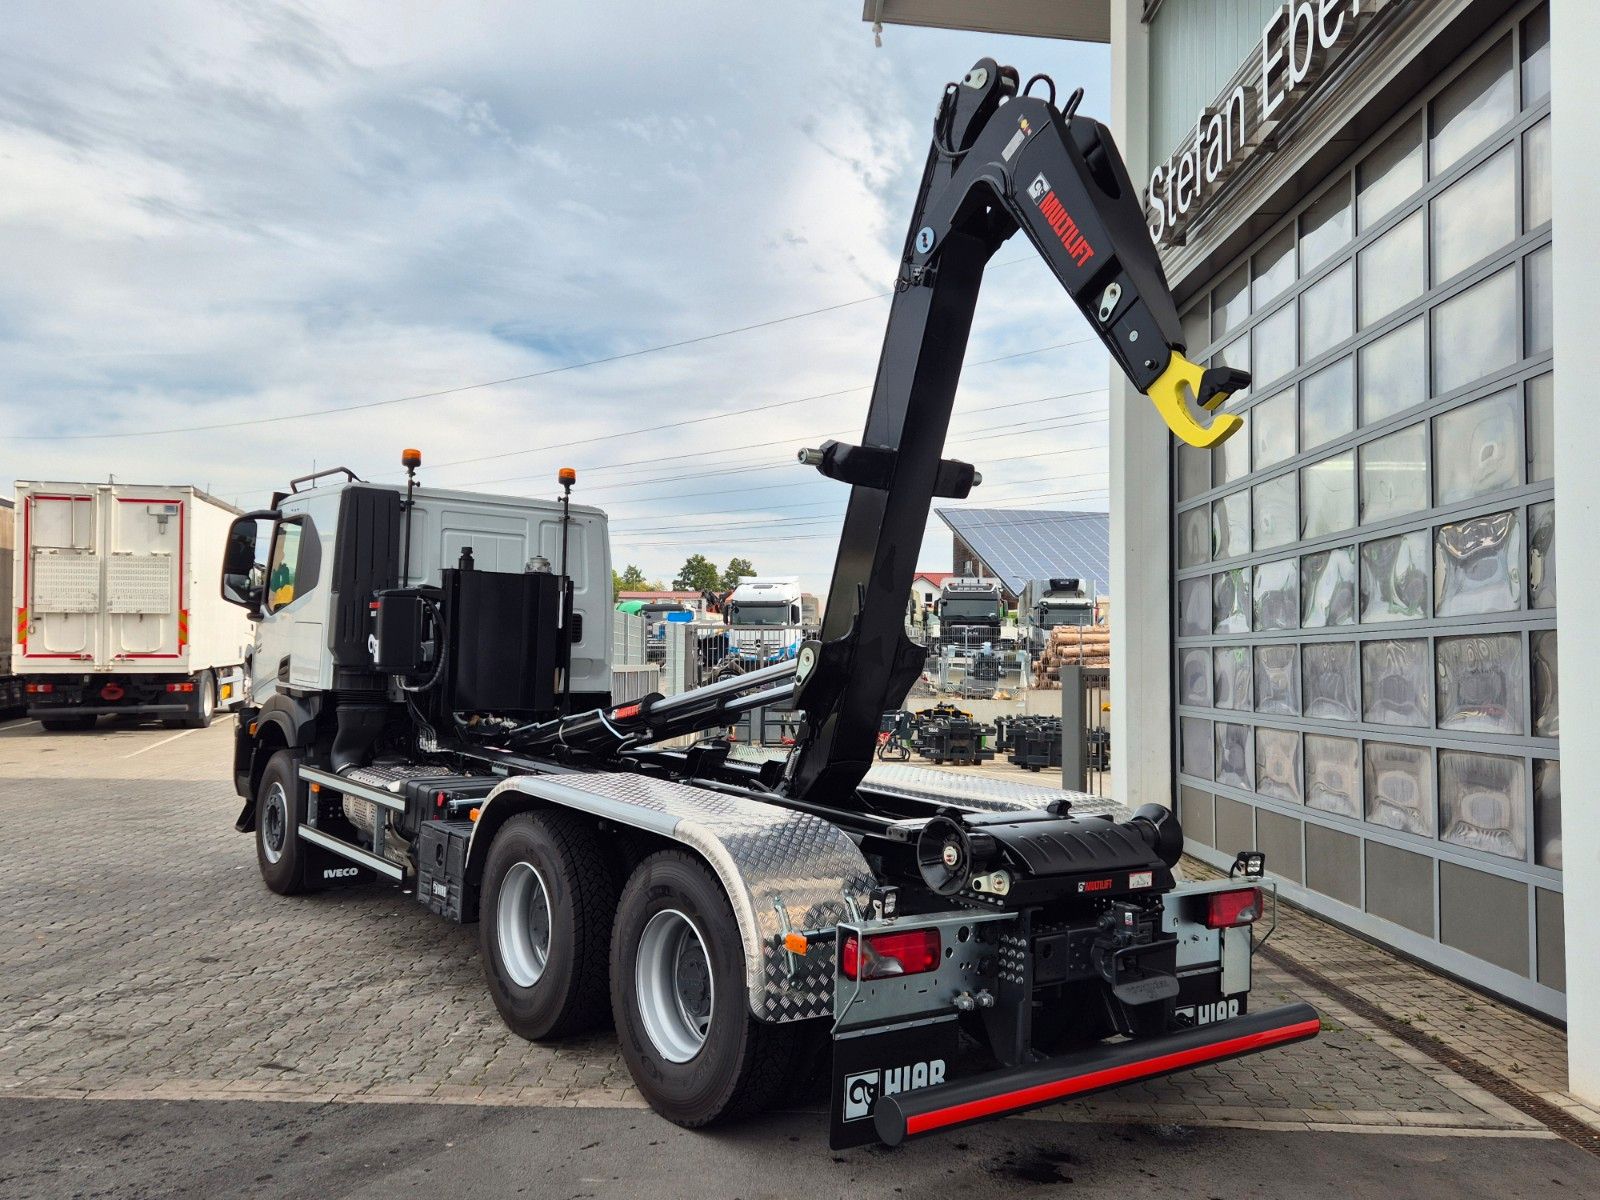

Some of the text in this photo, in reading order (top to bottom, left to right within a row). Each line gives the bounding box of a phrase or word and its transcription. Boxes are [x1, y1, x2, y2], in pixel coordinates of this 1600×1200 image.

[1149, 0, 1359, 245] Stefan Ebe
[1038, 189, 1096, 268] MULTILIFT
[323, 867, 359, 879] IVECO
